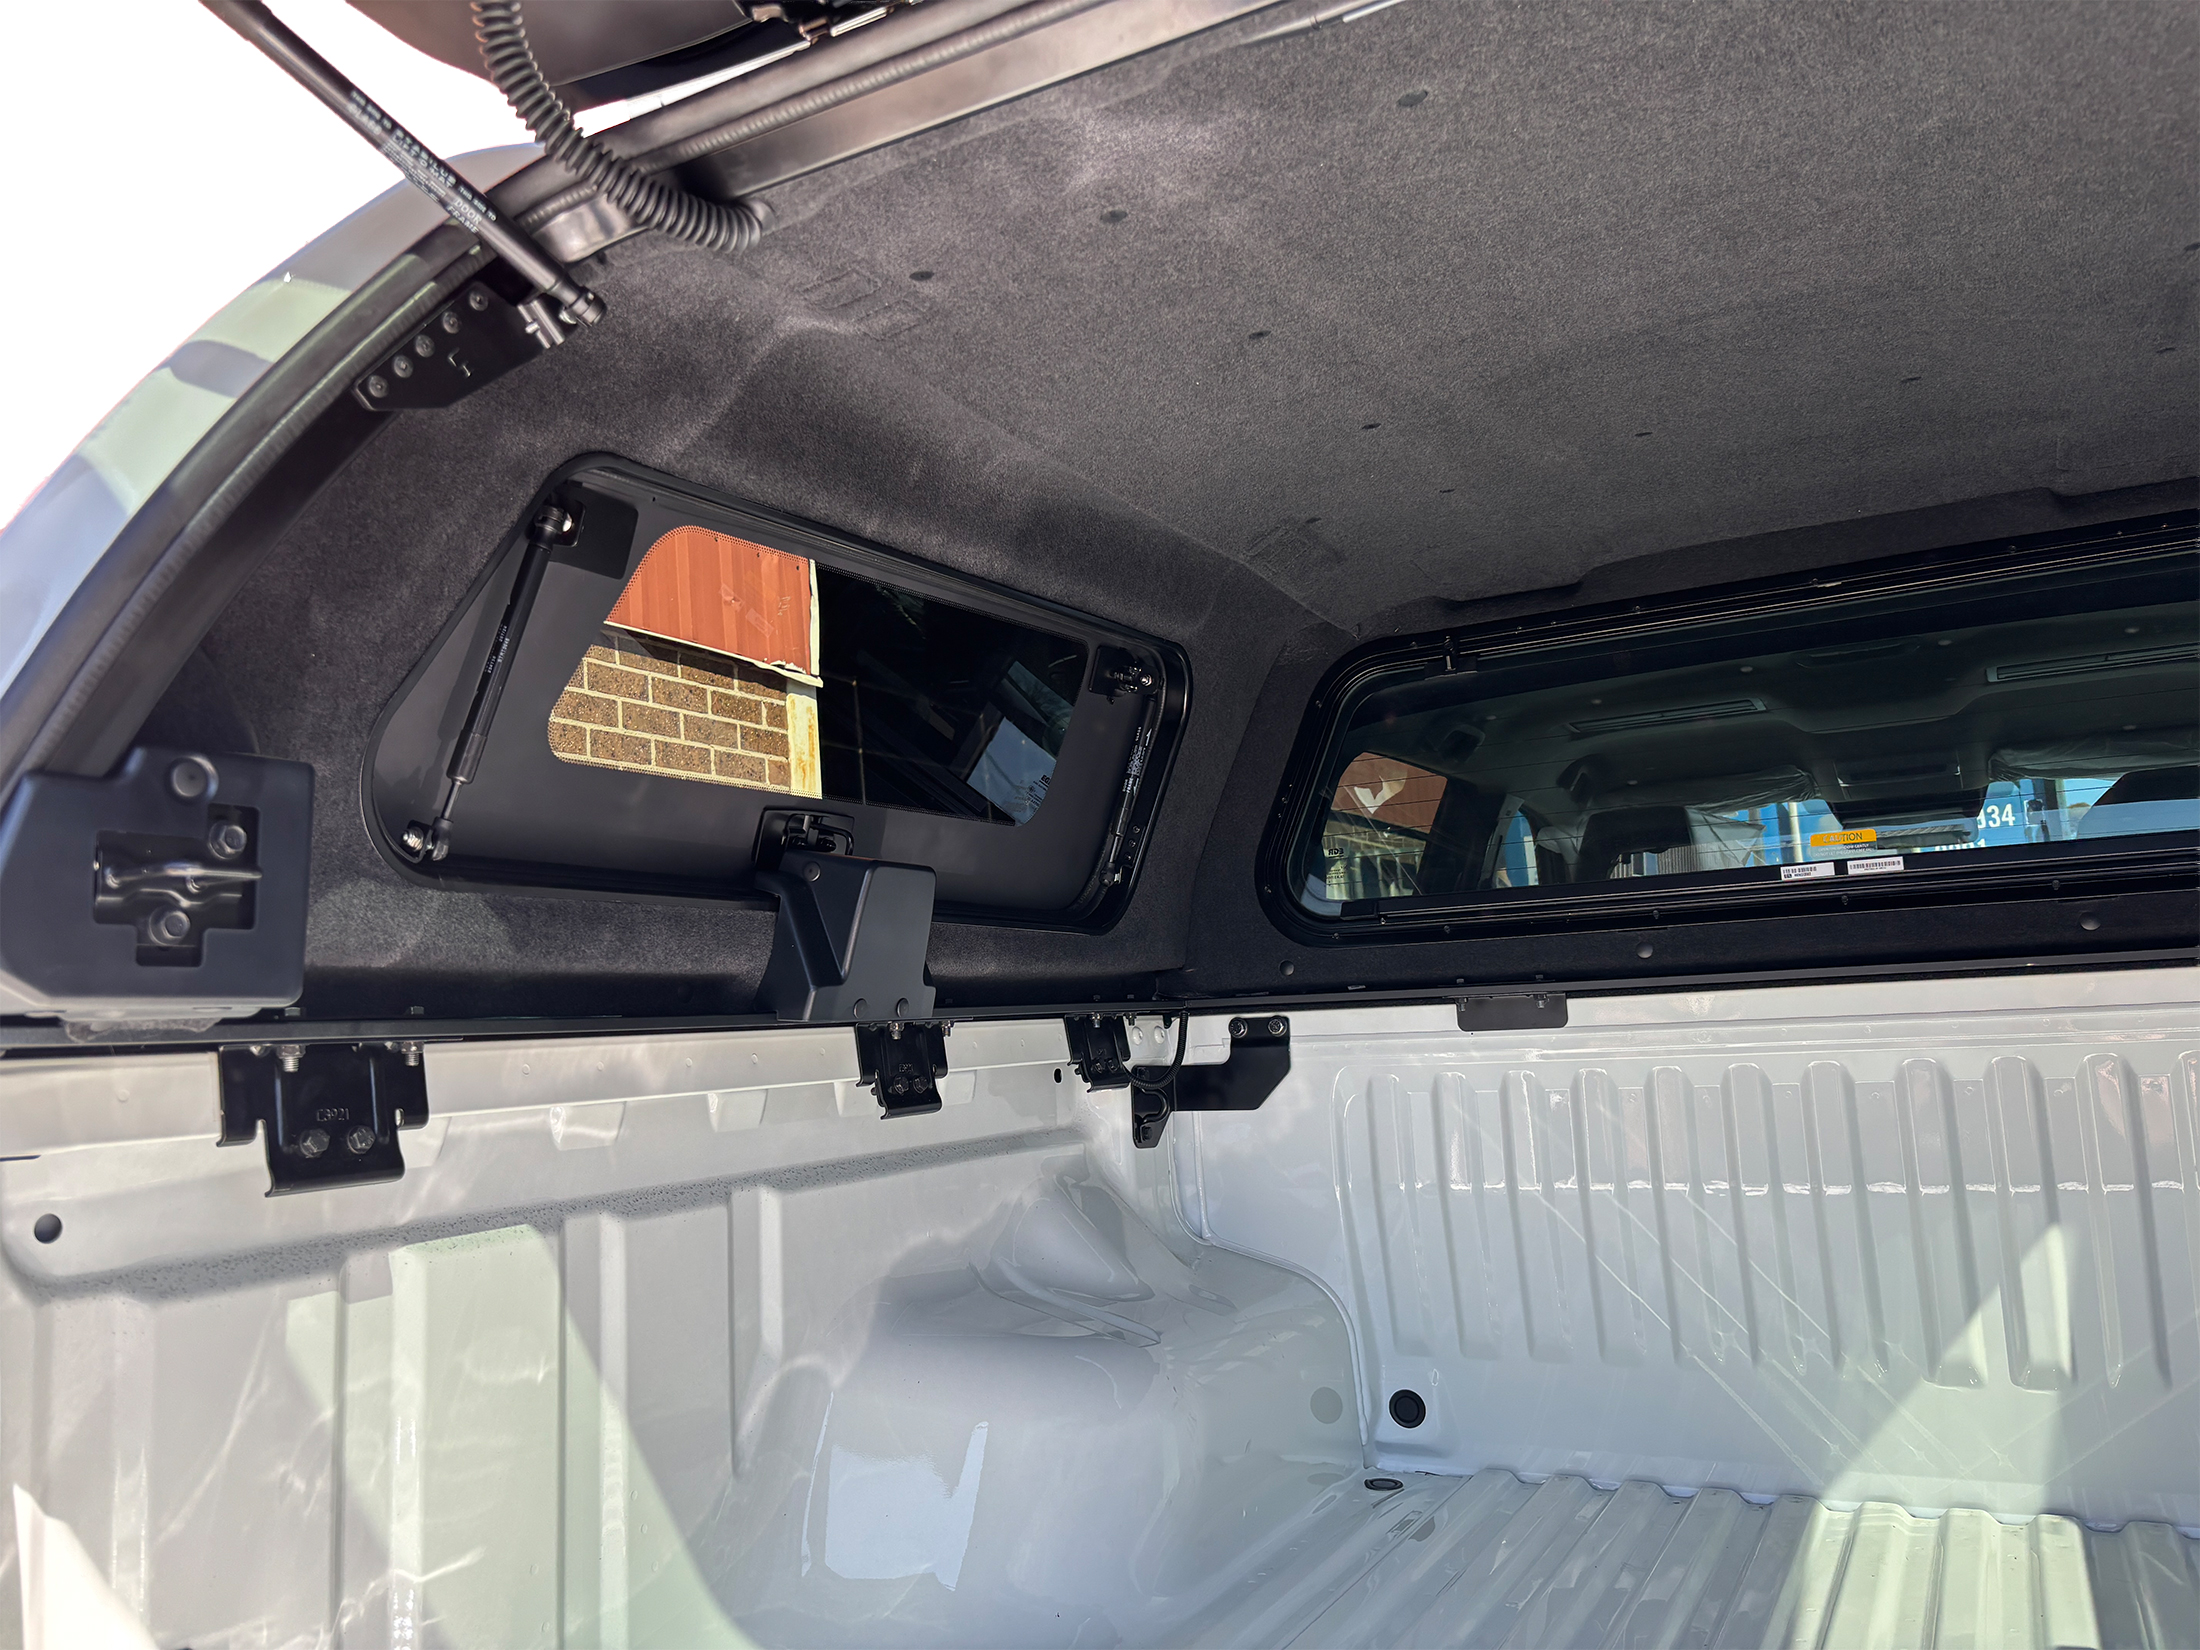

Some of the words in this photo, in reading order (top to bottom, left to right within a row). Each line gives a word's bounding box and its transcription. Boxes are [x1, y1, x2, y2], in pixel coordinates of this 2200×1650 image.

[395, 128, 457, 186] STABILUS
[447, 205, 480, 234] FRAME
[454, 197, 483, 225] DOOR
[1822, 832, 1863, 844] CAUTION
